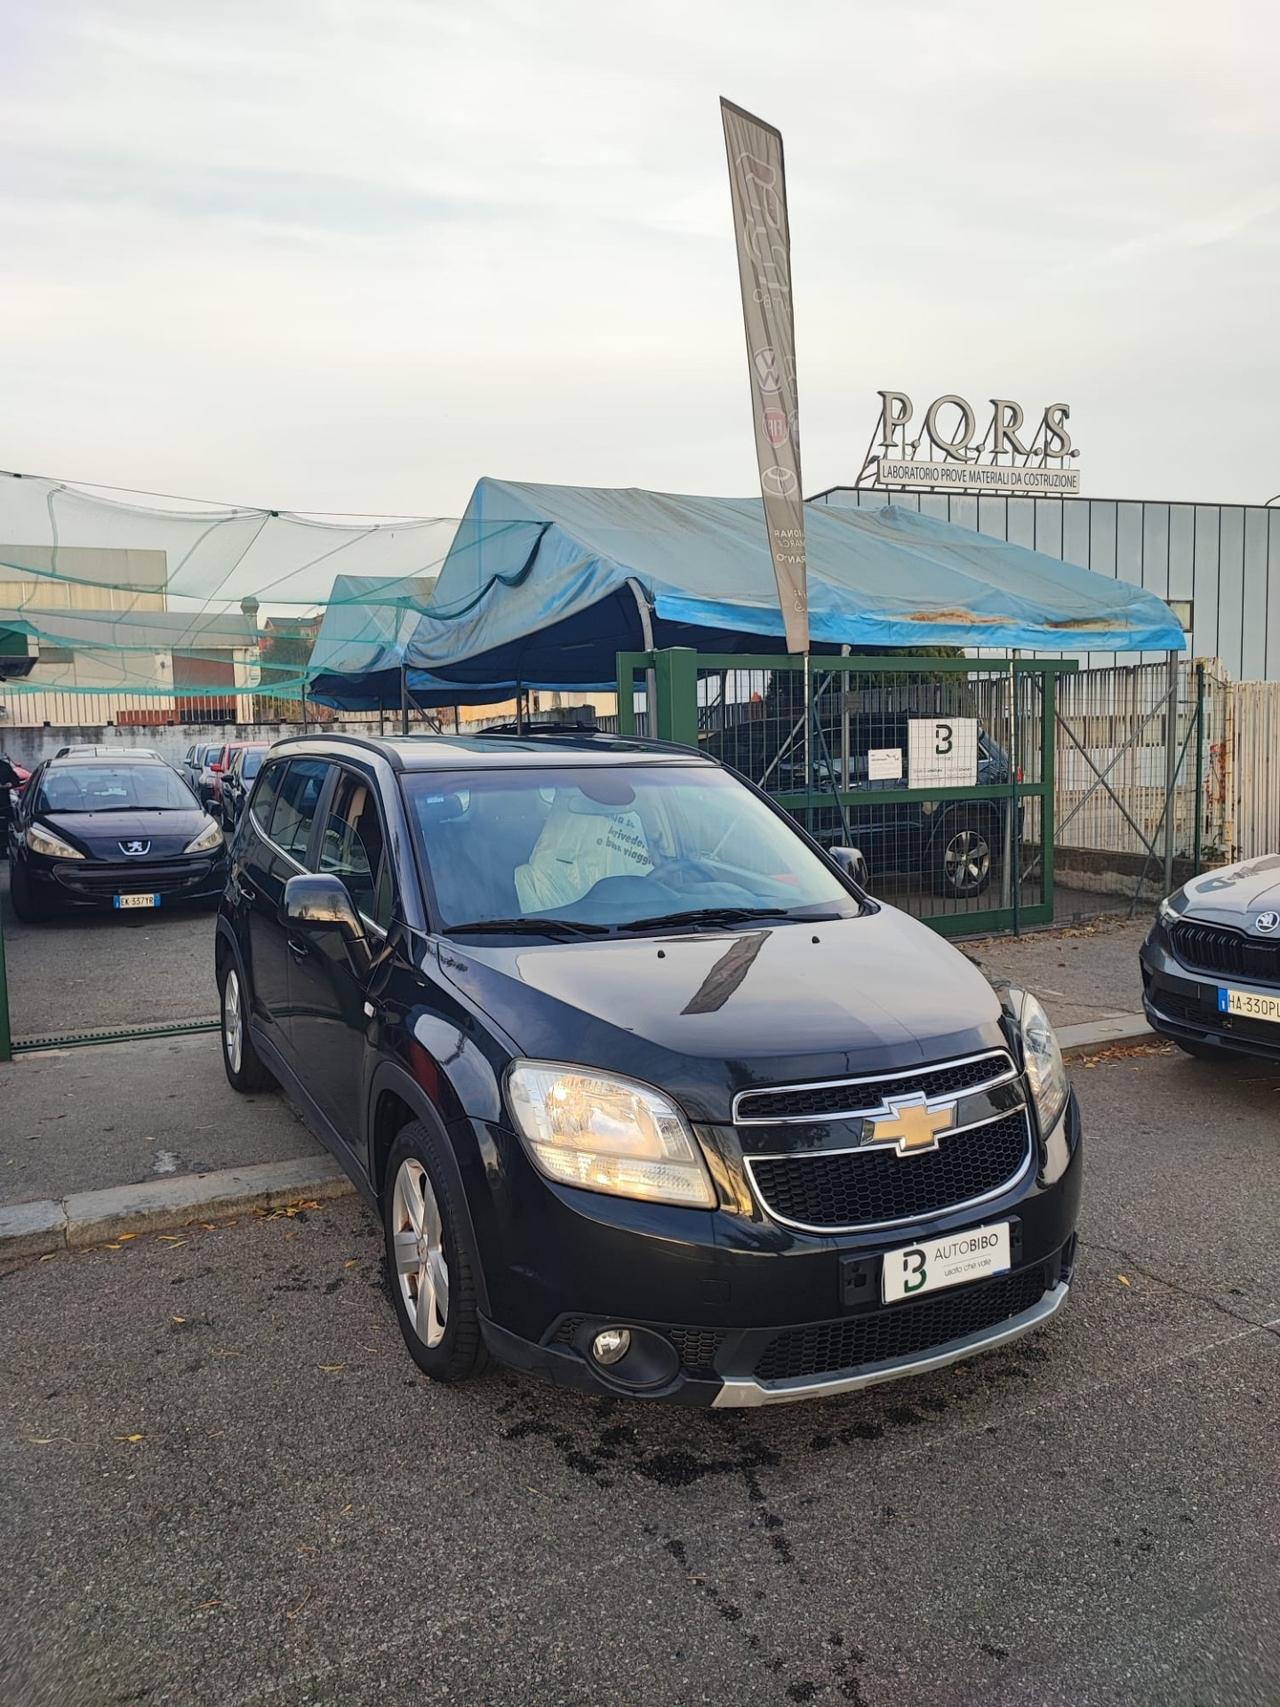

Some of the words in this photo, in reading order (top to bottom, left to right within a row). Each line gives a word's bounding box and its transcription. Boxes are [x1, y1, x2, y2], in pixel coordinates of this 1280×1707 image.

[877, 390, 1080, 461] P.Q.R.S.
[882, 465, 939, 481] LABORATORIO
[941, 468, 967, 482] PROVE
[969, 470, 1009, 485] MATERIALI
[1011, 473, 1022, 485] DA
[1023, 473, 1077, 488] COSTRUZIONE
[934, 1233, 999, 1262] AUTOBIBO
[944, 1265, 963, 1277] usato
[963, 1262, 977, 1272] che
